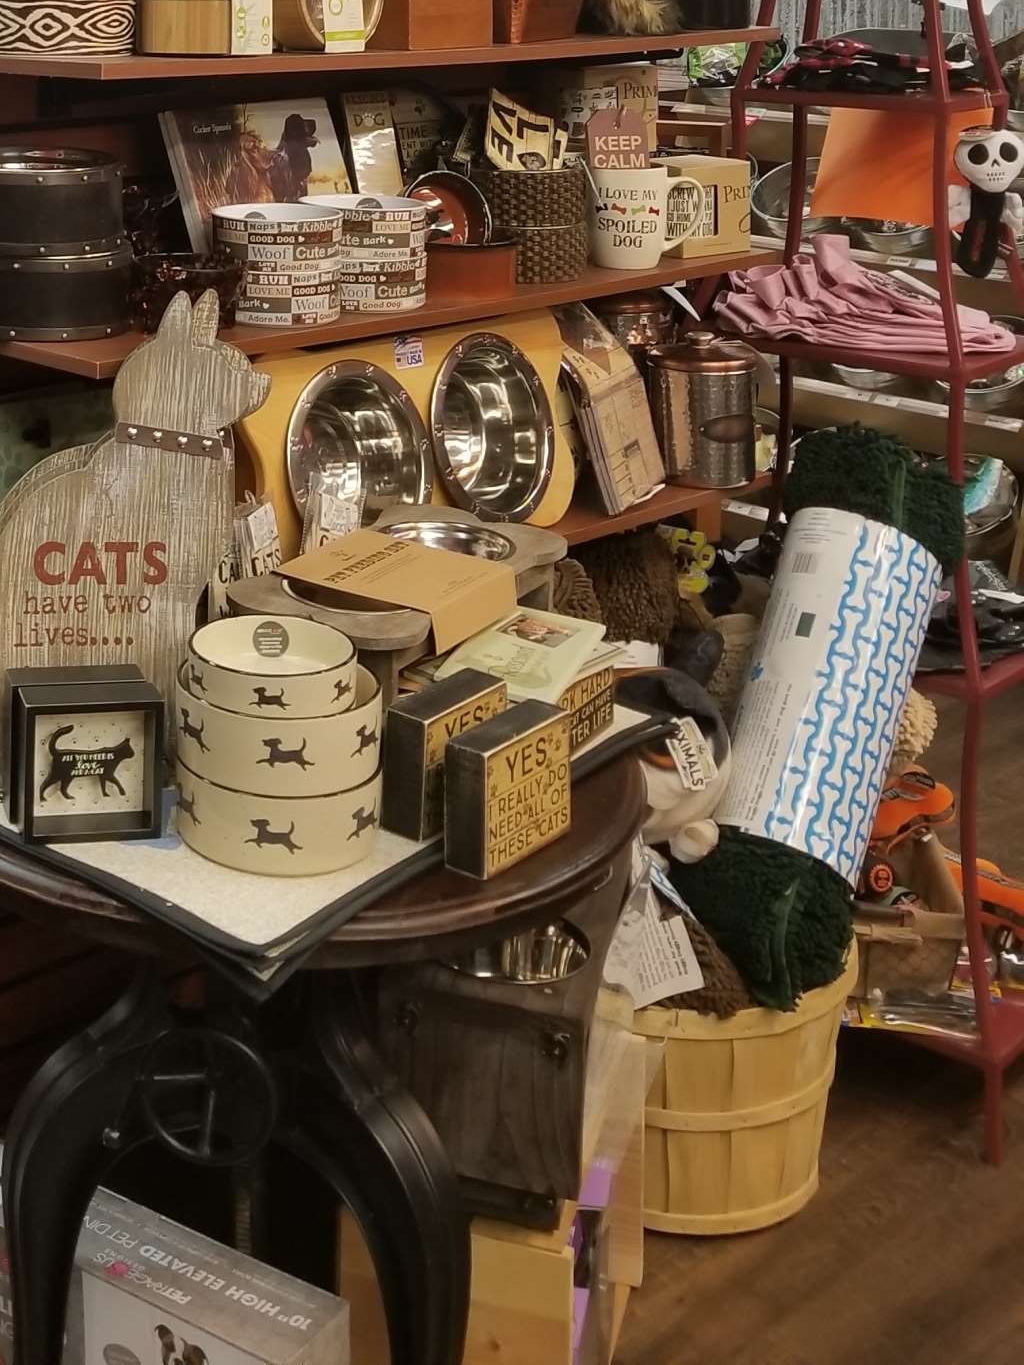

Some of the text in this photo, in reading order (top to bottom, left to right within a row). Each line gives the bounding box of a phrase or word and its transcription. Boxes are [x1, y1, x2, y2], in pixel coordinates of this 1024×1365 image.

[399, 125, 429, 139] TIME
[594, 135, 641, 151] KEEP
[594, 153, 645, 168] CALM
[606, 187, 638, 201] LOVE
[643, 187, 658, 202] MY
[668, 186, 695, 200] SCREW
[671, 200, 689, 212] JUST
[249, 222, 275, 233] Naps
[598, 217, 657, 234] SPOILED
[667, 222, 688, 236] WITH
[249, 235, 295, 243] GOOD DOG
[363, 236, 386, 245] Bark
[613, 234, 644, 248] DOG
[251, 245, 326, 260] Woof Cute
[304, 263, 319, 271] Dog
[294, 275, 317, 284] Naps
[249, 287, 273, 296] LOVE
[275, 287, 290, 296] ME
[294, 287, 316, 295] GOOD
[378, 285, 408, 298] Cute
[238, 298, 326, 312] Bark Woof
[386, 301, 401, 309] Dog
[248, 315, 273, 323] Adore
[406, 353, 423, 365] USA
[33, 541, 169, 586] CATS
[251, 548, 281, 576] CATS
[23, 591, 153, 615] have two
[13, 622, 135, 648] lives....
[581, 668, 612, 704] HARD
[580, 690, 612, 721] CAN HAVE
[593, 709, 614, 732] LIFE
[506, 736, 547, 783] YES
[499, 776, 542, 814] REALLY
[548, 763, 568, 788] DO
[489, 785, 568, 843] NEED ALL OF
[489, 806, 568, 867] THESE CATS
[107, 1227, 138, 1250] PET
[138, 1245, 226, 1292] ELEVATED
[225, 1285, 281, 1318] HIGH
